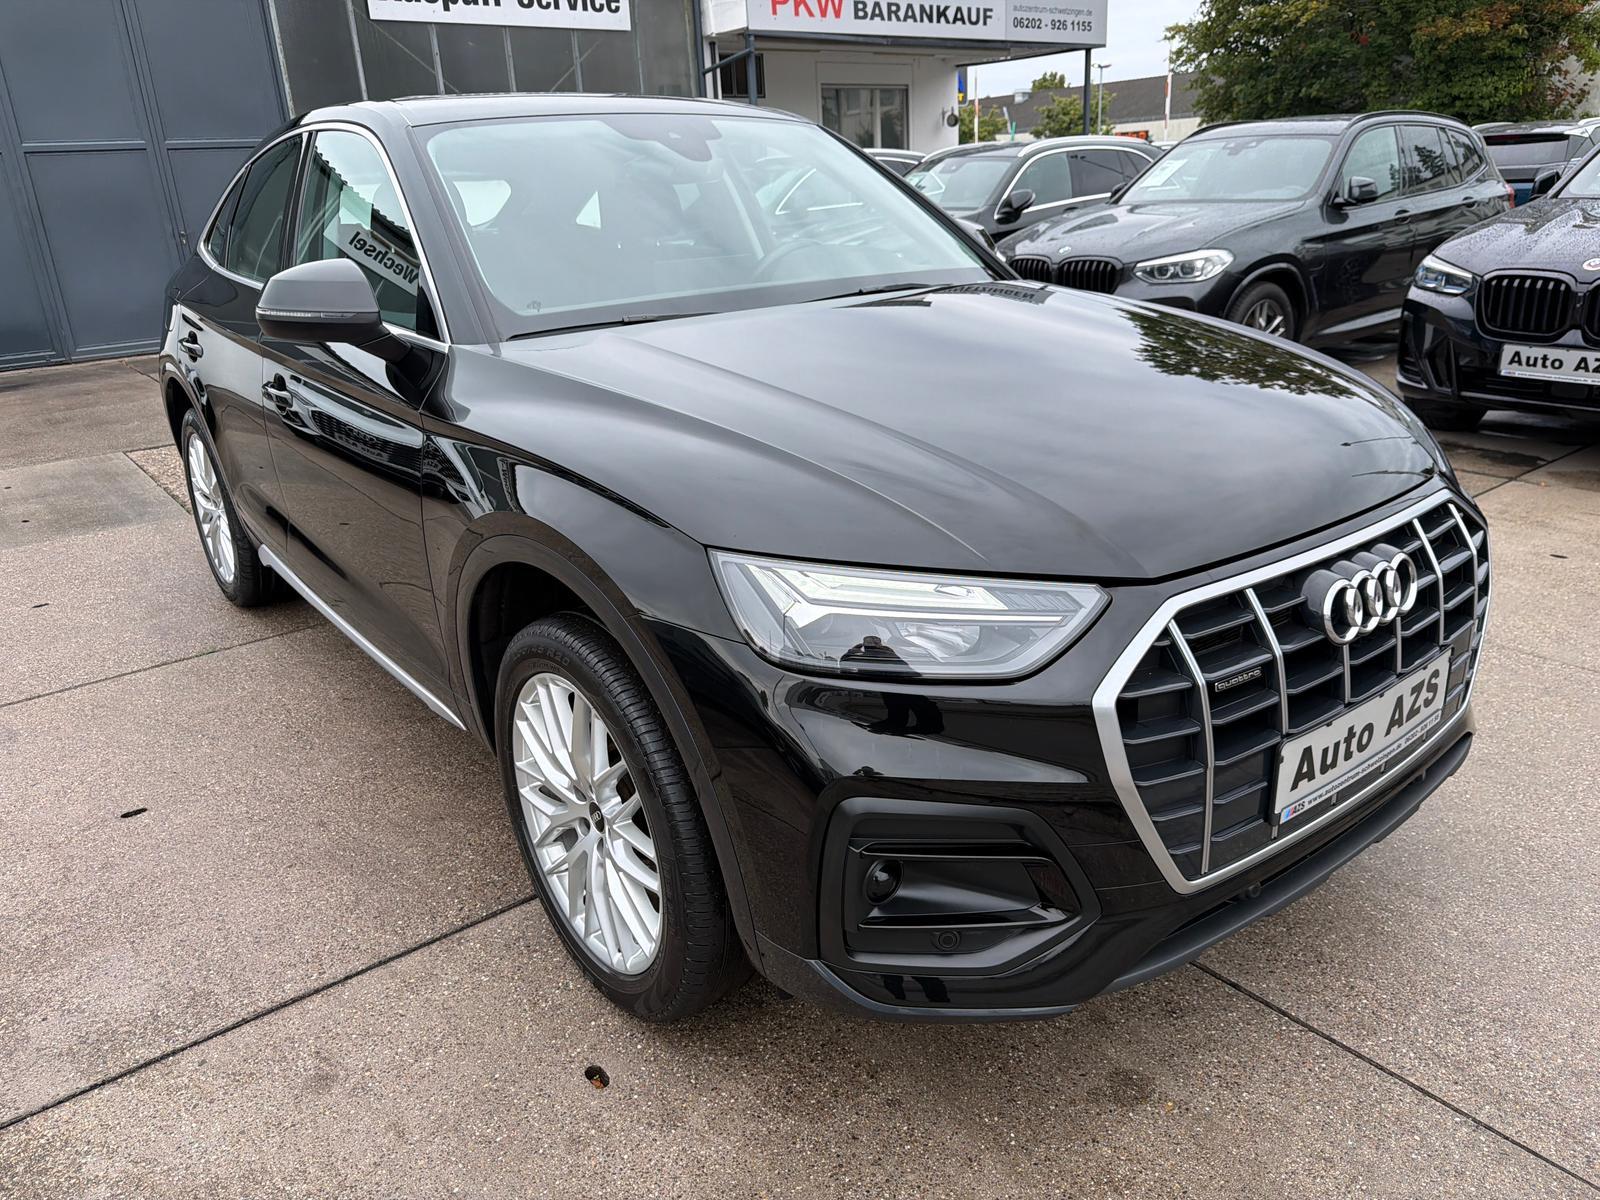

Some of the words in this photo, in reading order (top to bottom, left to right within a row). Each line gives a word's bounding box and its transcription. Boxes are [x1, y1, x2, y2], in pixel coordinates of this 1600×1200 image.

[771, 0, 843, 19] PKW
[853, 1, 993, 26] BARANKAUF
[1013, 16, 1042, 30] 06202
[1050, 19, 1068, 31] 926
[1070, 20, 1093, 32] 1155
[1508, 351, 1563, 370] Auto
[1217, 669, 1262, 691] quattro
[1290, 722, 1374, 792] Auto
[1384, 668, 1440, 737] AZS
